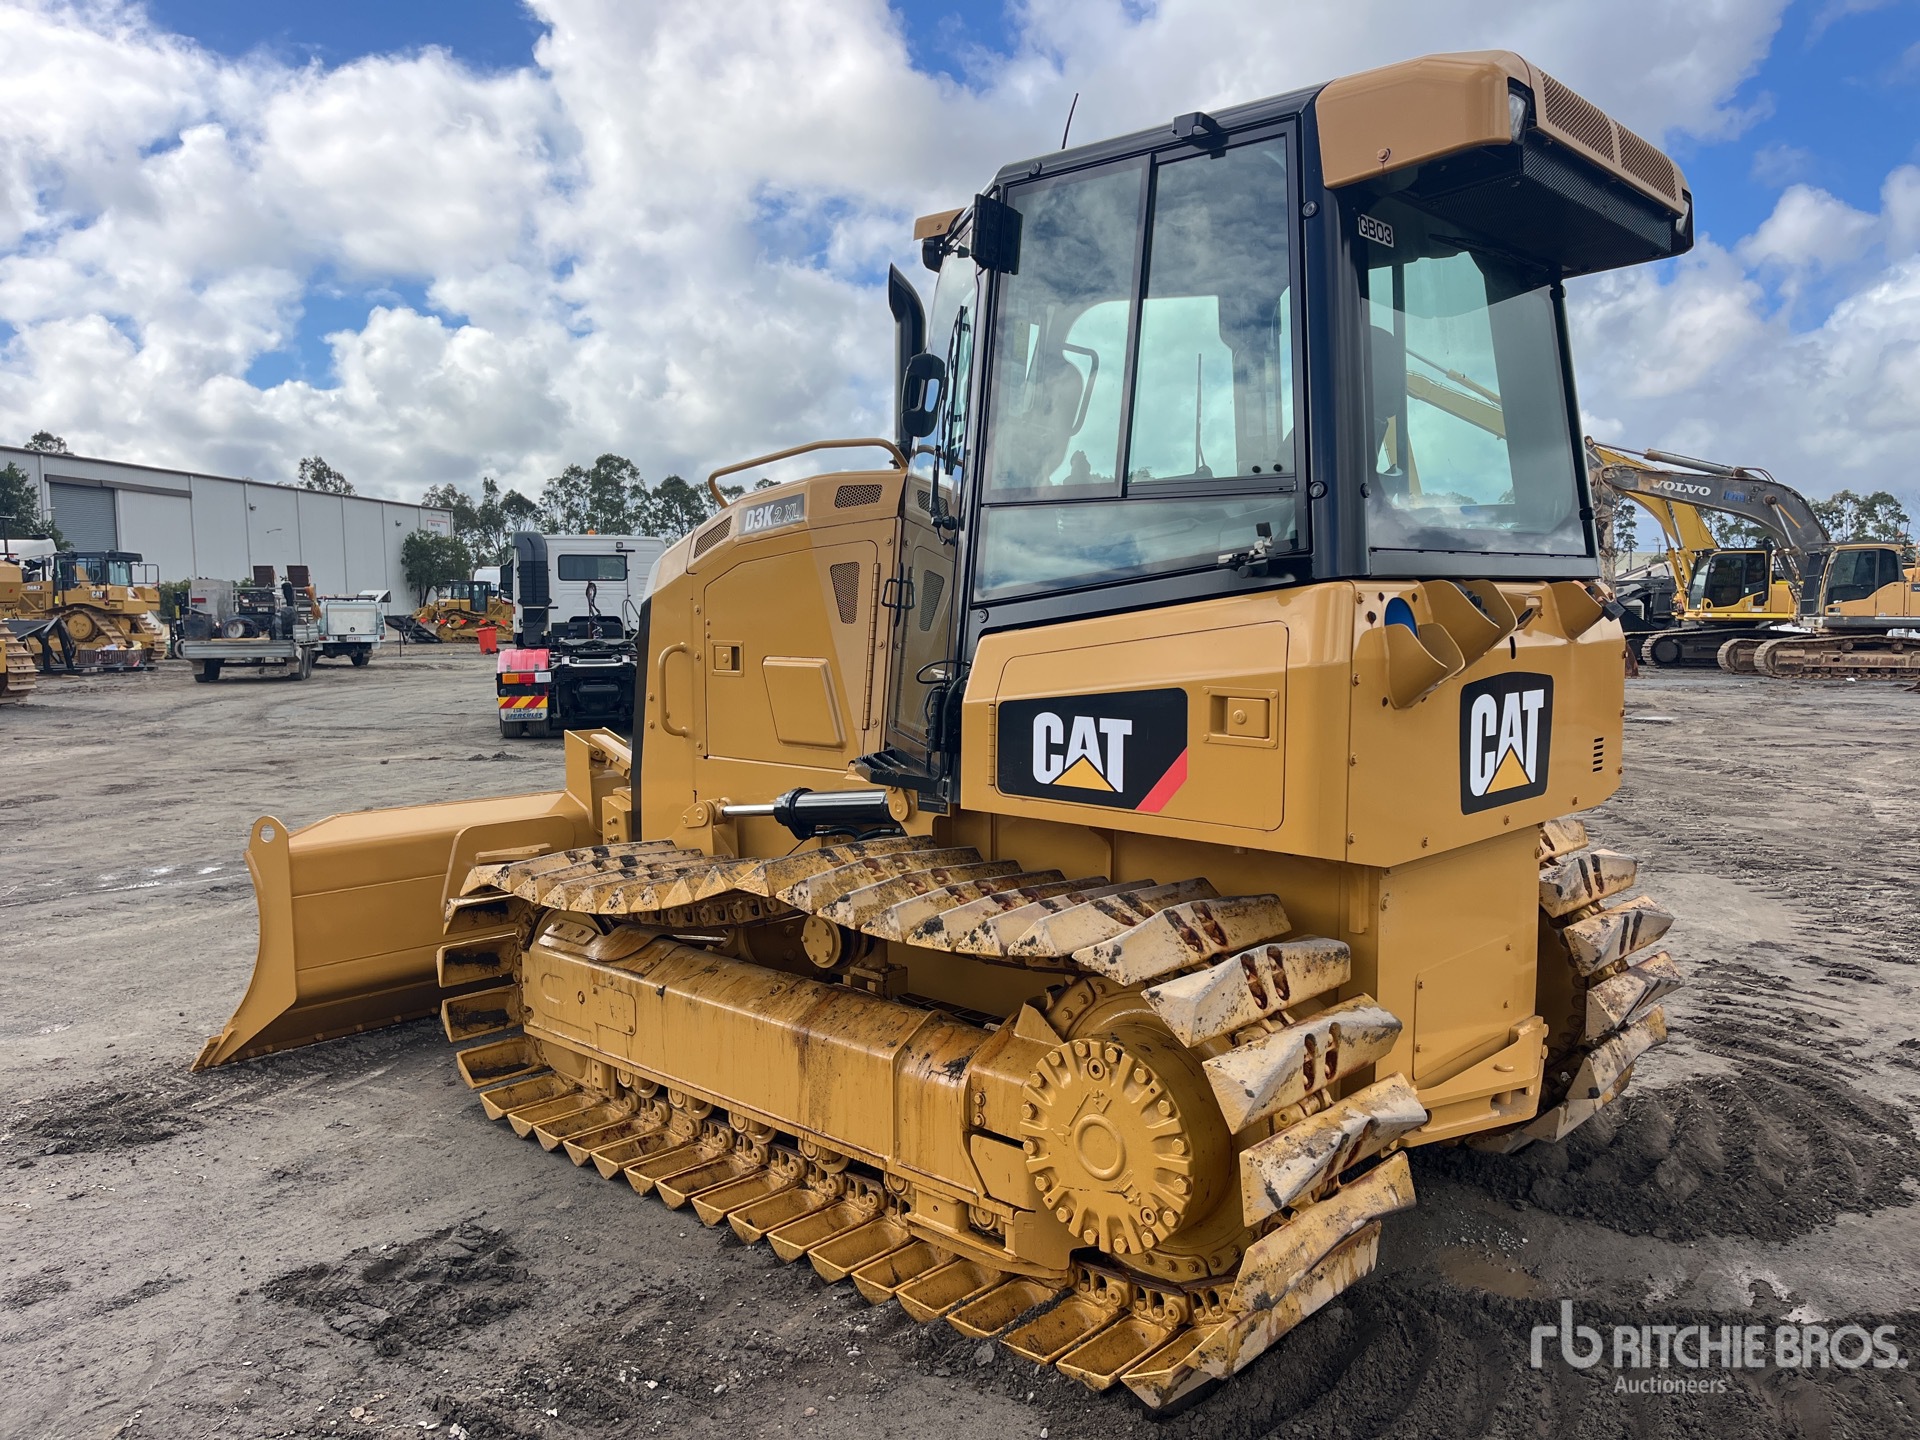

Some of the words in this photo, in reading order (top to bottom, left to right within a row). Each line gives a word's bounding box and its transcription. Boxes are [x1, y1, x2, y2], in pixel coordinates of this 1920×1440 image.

[1360, 215, 1392, 244] GB03
[1651, 480, 1711, 496] VOLVO
[783, 503, 799, 523] XL
[1033, 712, 1132, 793] CAT
[1470, 689, 1545, 797] CAT
